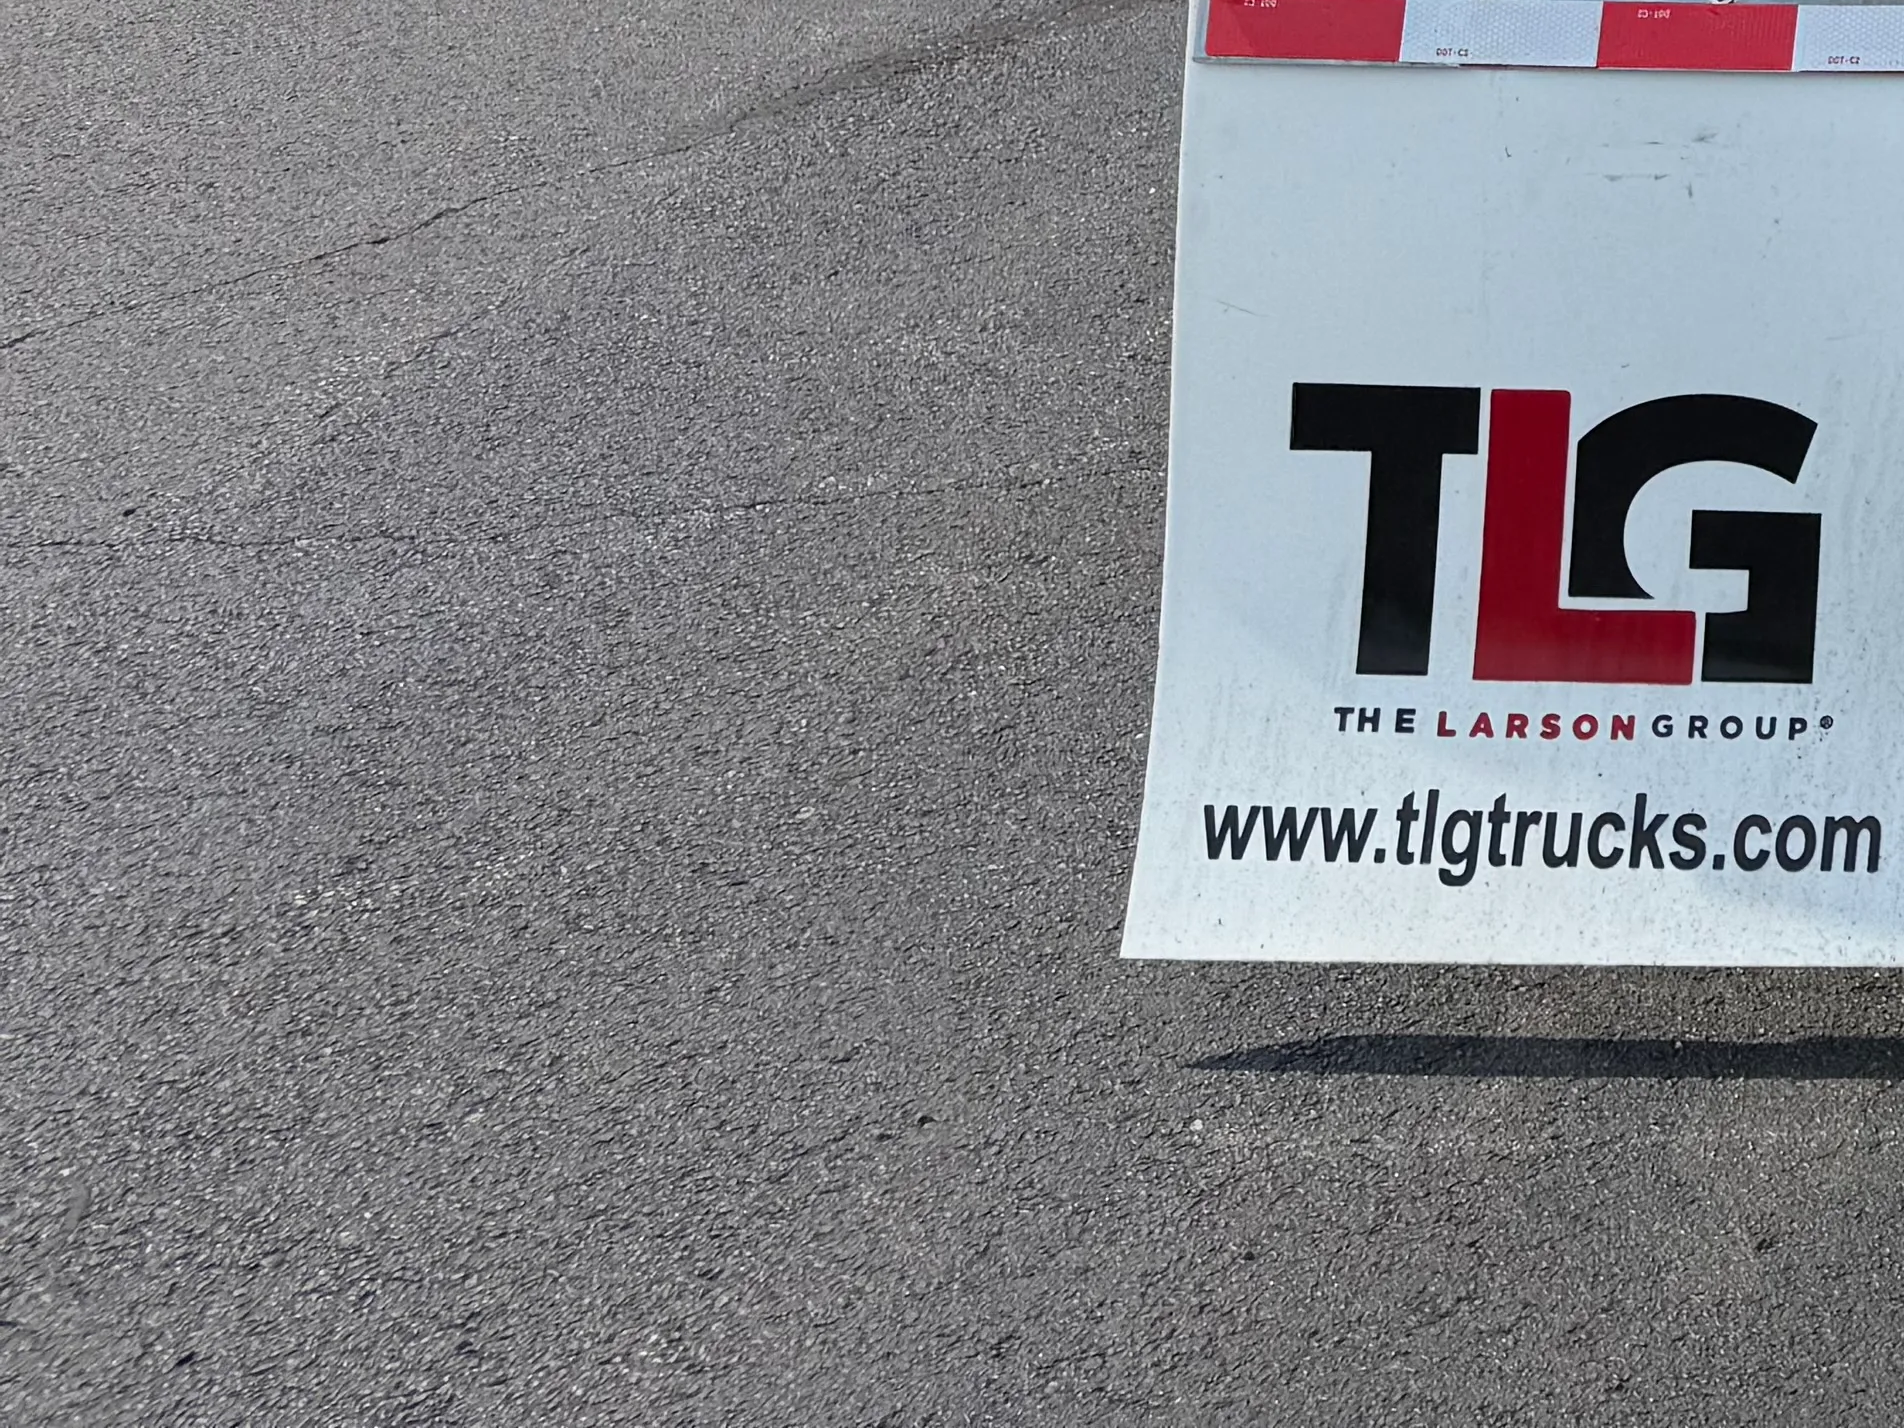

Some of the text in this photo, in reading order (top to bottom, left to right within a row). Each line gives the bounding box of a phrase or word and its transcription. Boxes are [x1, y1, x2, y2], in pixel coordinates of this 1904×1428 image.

[1290, 382, 1823, 685] TLG
[1333, 706, 1416, 735] THE
[1436, 710, 1636, 741] LARSON
[1202, 788, 1882, 888] www.tlgtrucks.com
